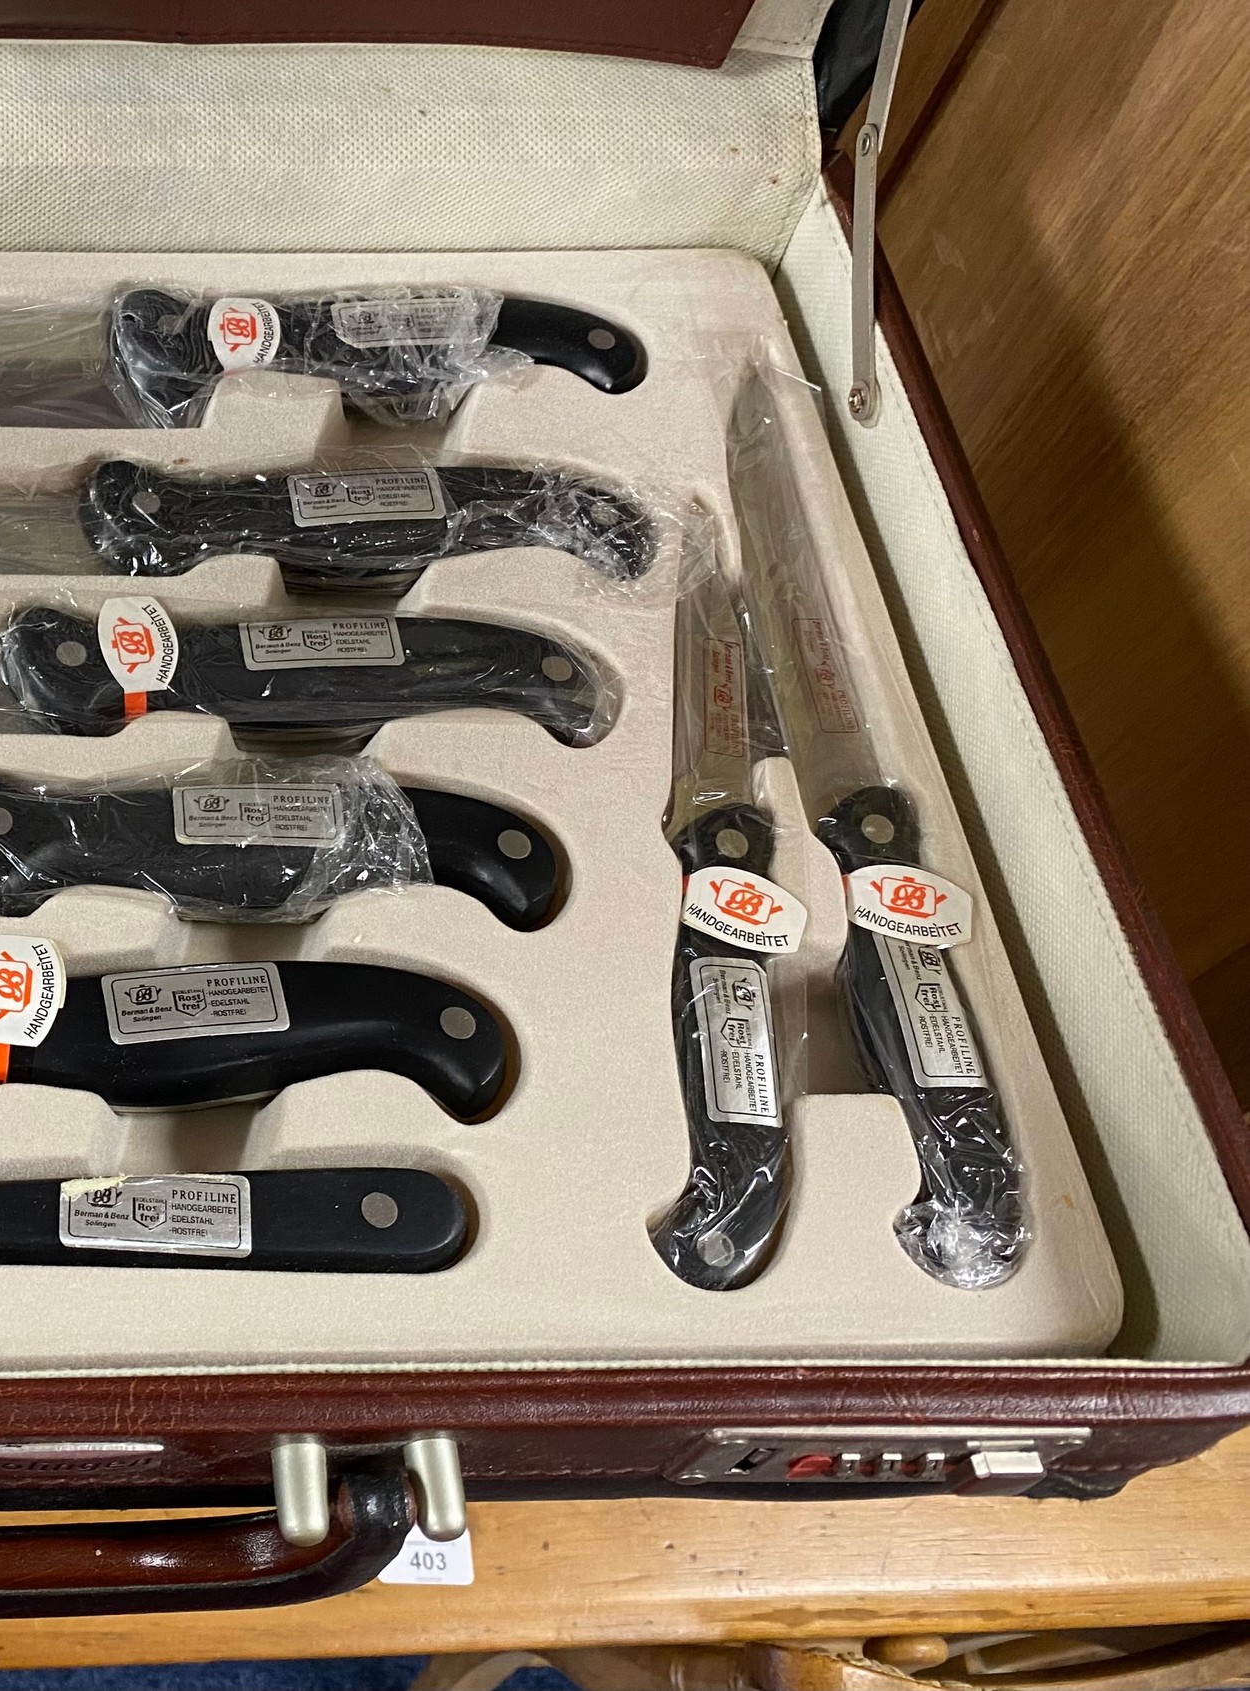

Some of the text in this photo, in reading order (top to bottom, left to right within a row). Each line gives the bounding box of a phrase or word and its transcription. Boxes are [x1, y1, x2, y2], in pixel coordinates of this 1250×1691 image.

[250, 301, 275, 364] HANDGEARBEITET
[374, 477, 427, 486] PROFILINE
[331, 621, 387, 630] PROFILINE
[141, 604, 174, 684] HANDGEARBEITET
[306, 633, 328, 641] Rost
[273, 795, 330, 804] PROFILINE
[246, 814, 265, 822] frei
[685, 902, 790, 948] HANDGEARBEITET
[853, 905, 963, 938] HANDGEARBEITET
[913, 965, 922, 981] Benz
[206, 975, 268, 988] PROFILINE
[23, 943, 55, 1039] HANDGEARBEITET
[177, 993, 202, 1002] Rost
[920, 989, 931, 1007] frei
[929, 987, 942, 1009] Rost
[121, 1008, 149, 1017] Berman
[181, 1002, 201, 1010] frei
[132, 1014, 162, 1023] Solingen
[727, 1024, 736, 1042] frei
[737, 1022, 748, 1045] Rost
[952, 1016, 976, 1075] PROFILINE
[754, 1053, 770, 1114] PROFILINE
[171, 1189, 238, 1204] PROFILINE
[74, 1209, 104, 1218] Berman
[110, 1212, 130, 1220] Benz
[140, 1213, 160, 1222] frei
[85, 1219, 116, 1228] Solingen
[410, 1551, 447, 1571] 403
